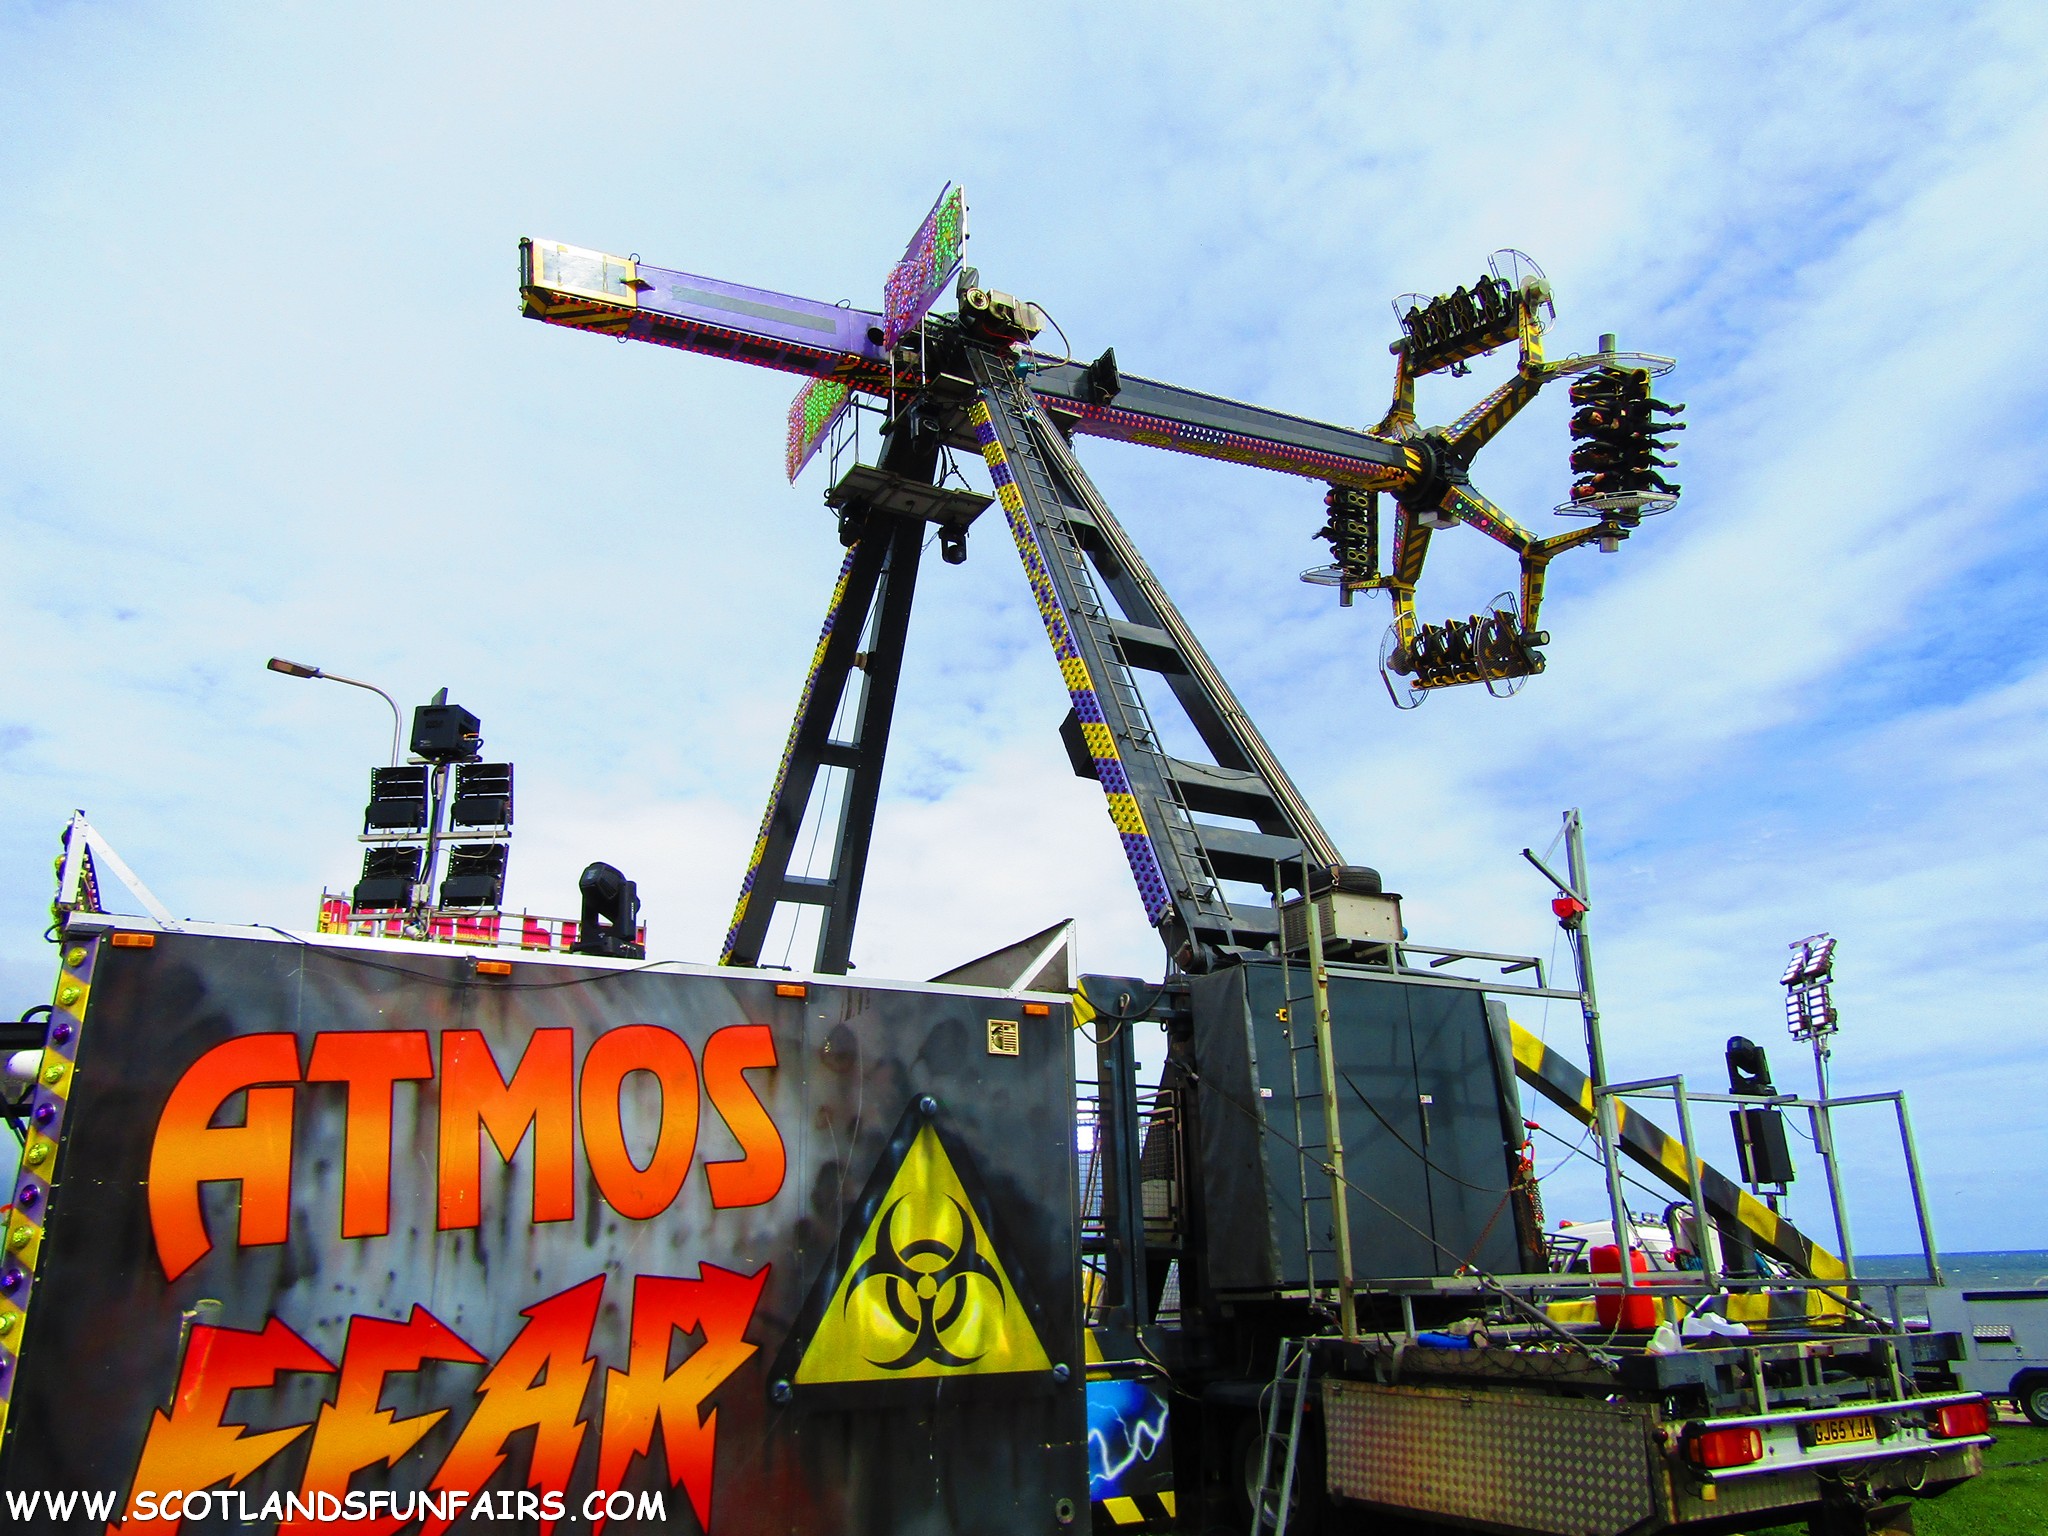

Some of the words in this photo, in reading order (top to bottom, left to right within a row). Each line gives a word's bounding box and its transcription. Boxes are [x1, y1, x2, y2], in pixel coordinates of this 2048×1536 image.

[148, 1023, 787, 1283] ATMOS
[105, 1261, 771, 1536] FEAR
[1814, 1420, 1846, 1442] GJ65
[1848, 1416, 1873, 1438] YJA
